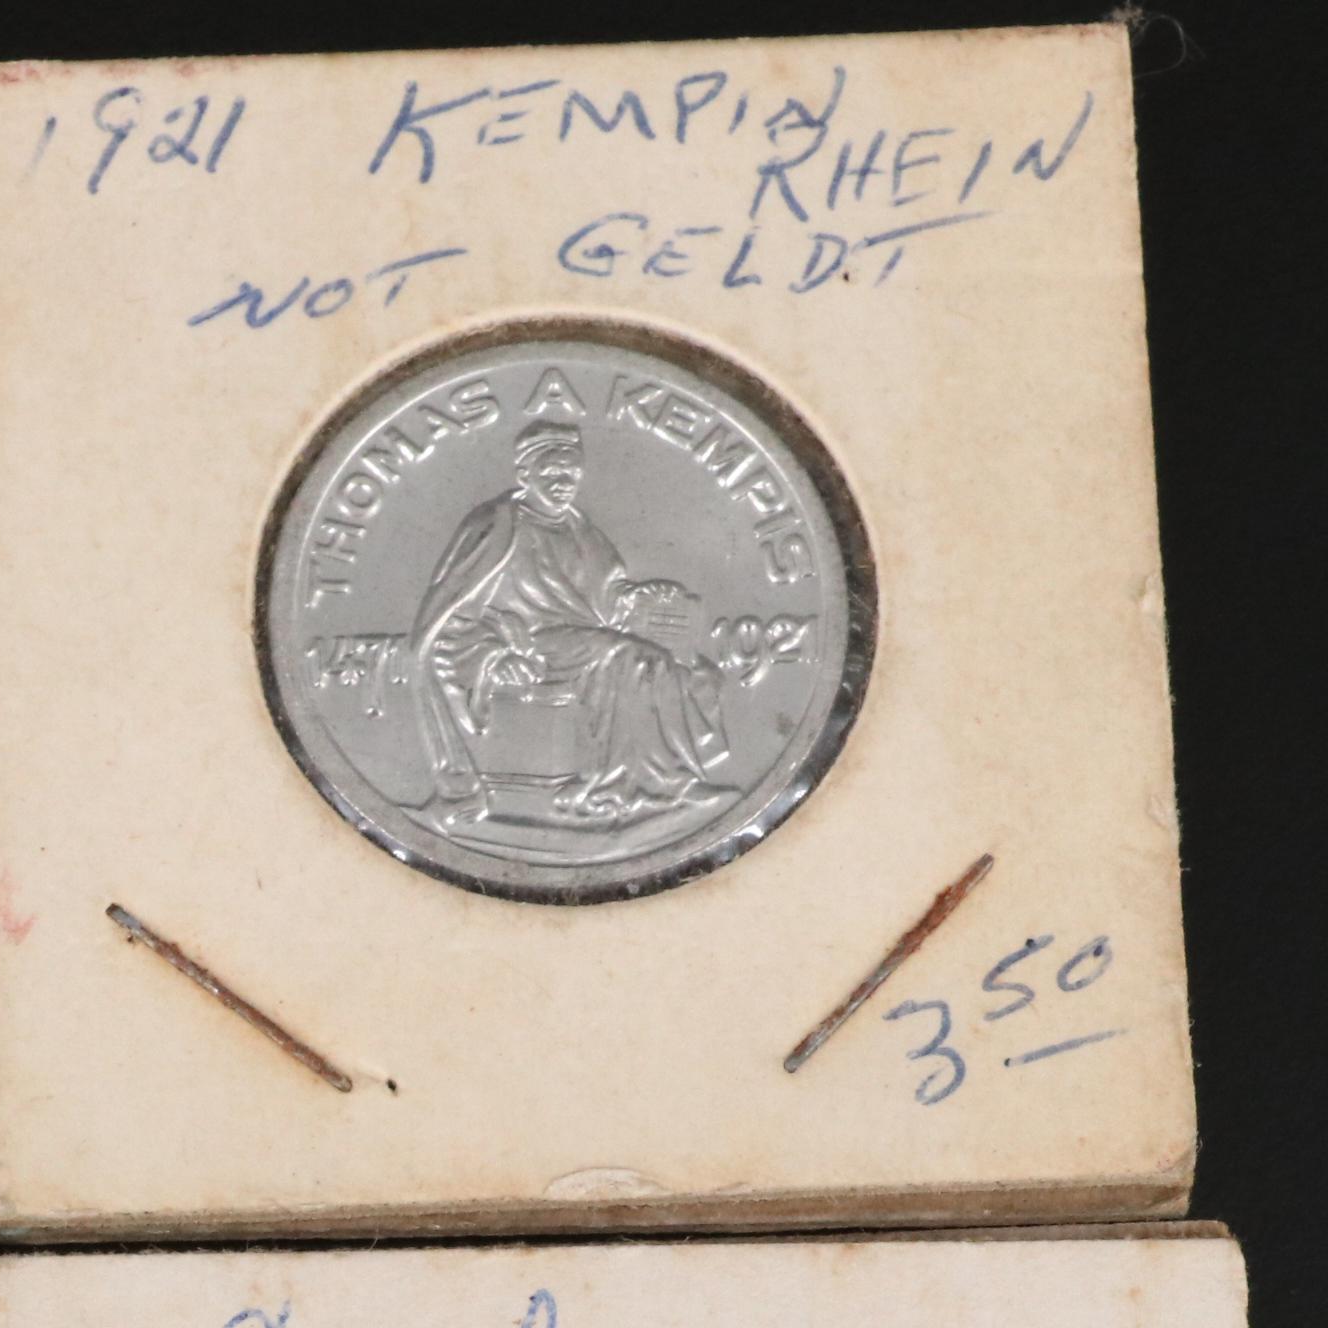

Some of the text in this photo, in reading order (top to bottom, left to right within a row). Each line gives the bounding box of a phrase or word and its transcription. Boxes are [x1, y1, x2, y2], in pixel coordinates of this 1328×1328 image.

[24, 86, 246, 194] 1921
[749, 90, 1094, 222] RHEIN
[188, 247, 468, 329] NOT
[303, 366, 818, 609] THOMAS A KEMPIS
